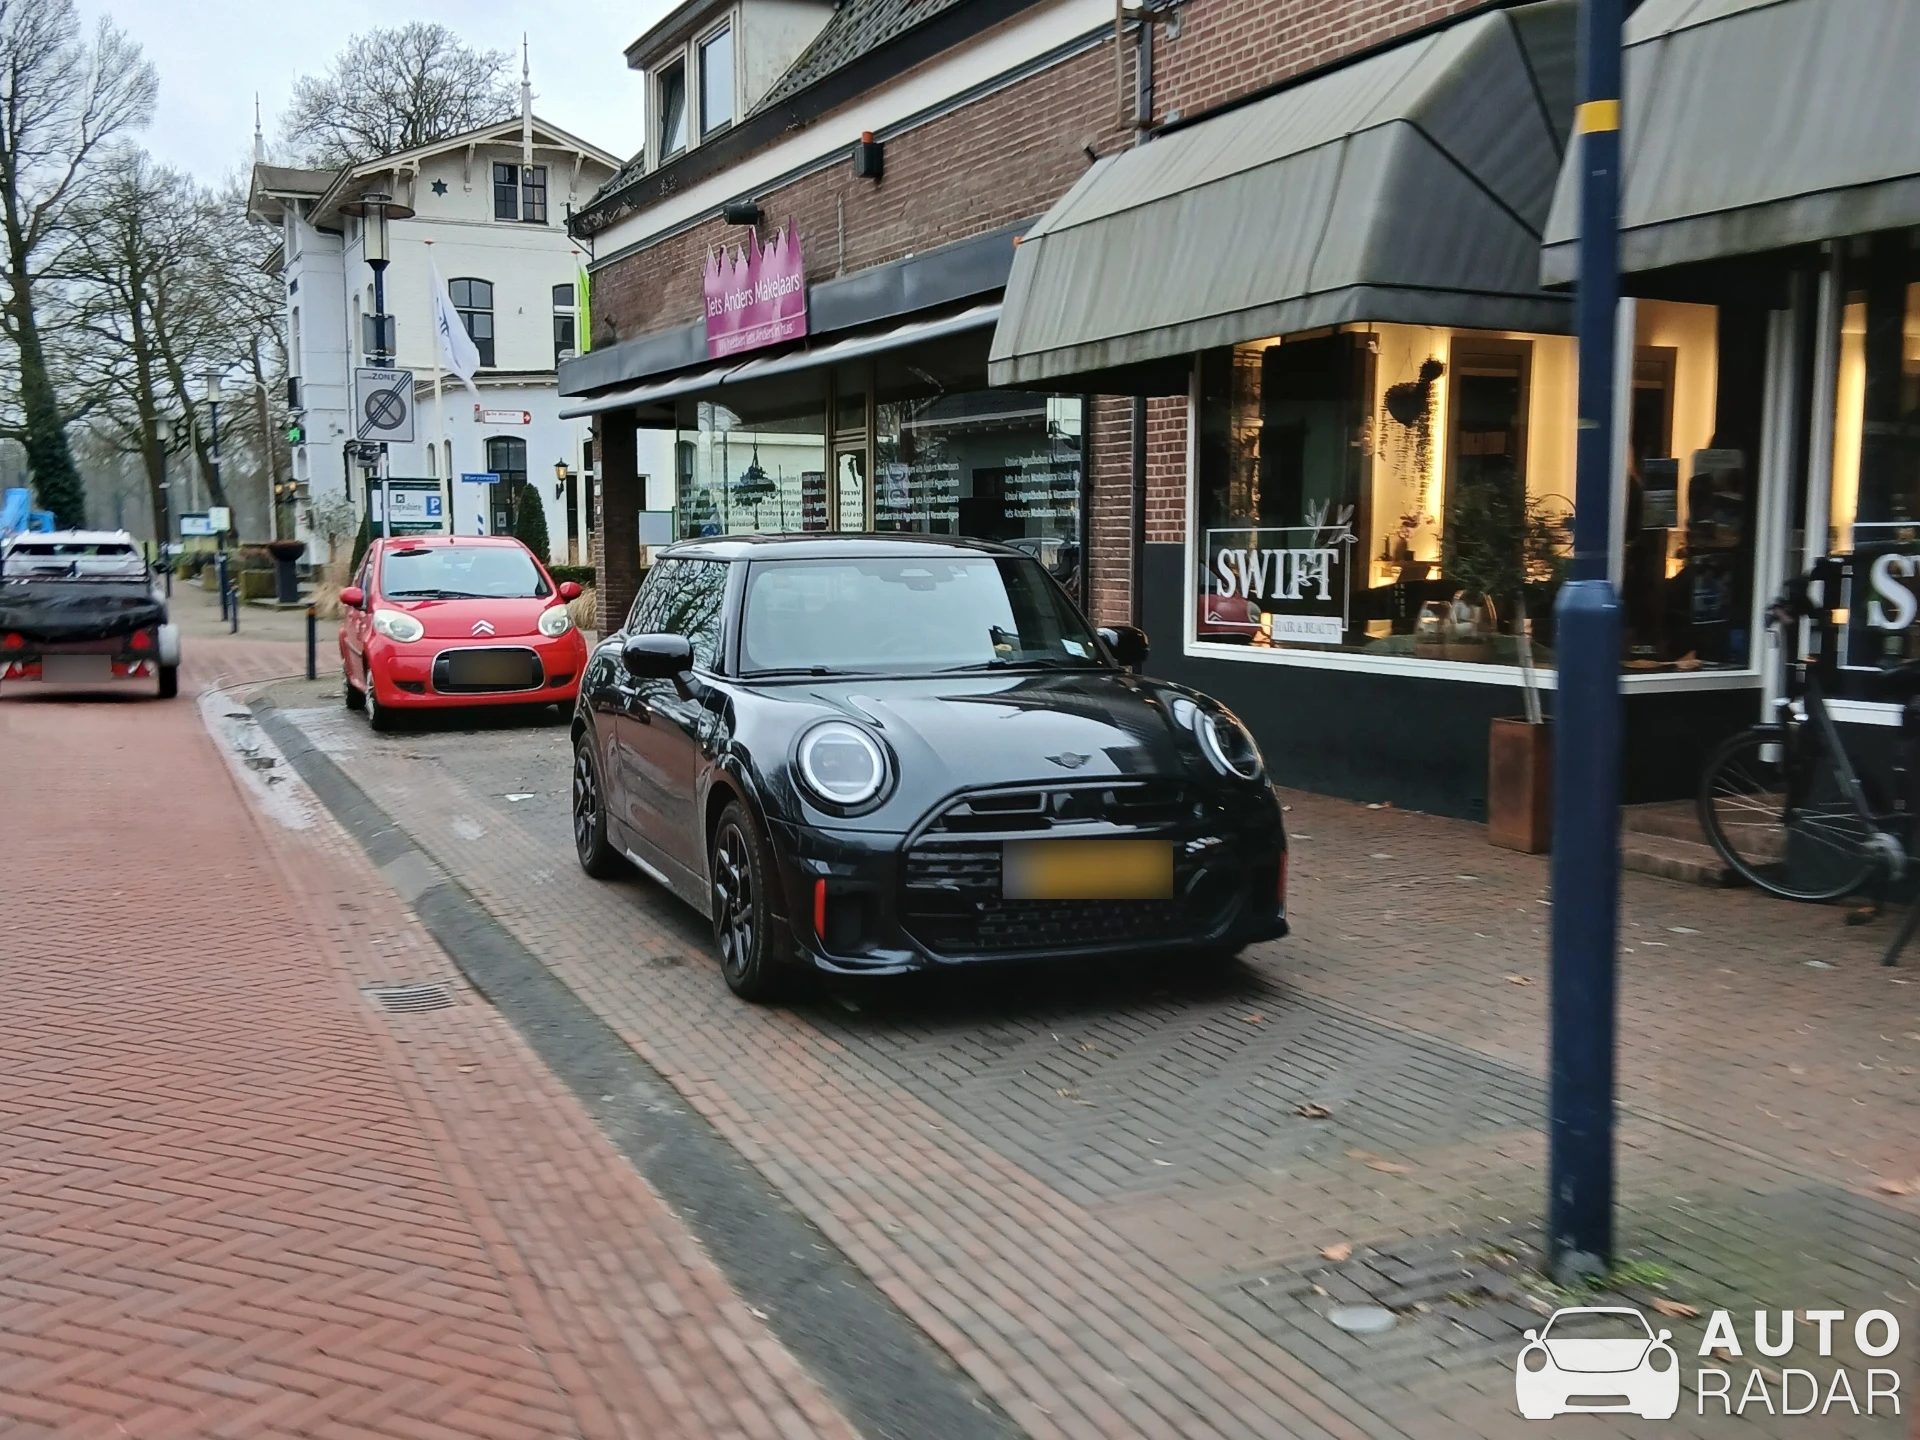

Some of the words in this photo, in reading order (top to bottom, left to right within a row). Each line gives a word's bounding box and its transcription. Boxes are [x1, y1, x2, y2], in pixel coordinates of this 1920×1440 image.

[706, 296, 722, 317] Iets
[724, 287, 753, 313] Anders
[755, 273, 800, 304] Makelaars
[372, 372, 397, 382] ZONE
[1217, 548, 1339, 600] SWIFT
[1867, 553, 1920, 630] S
